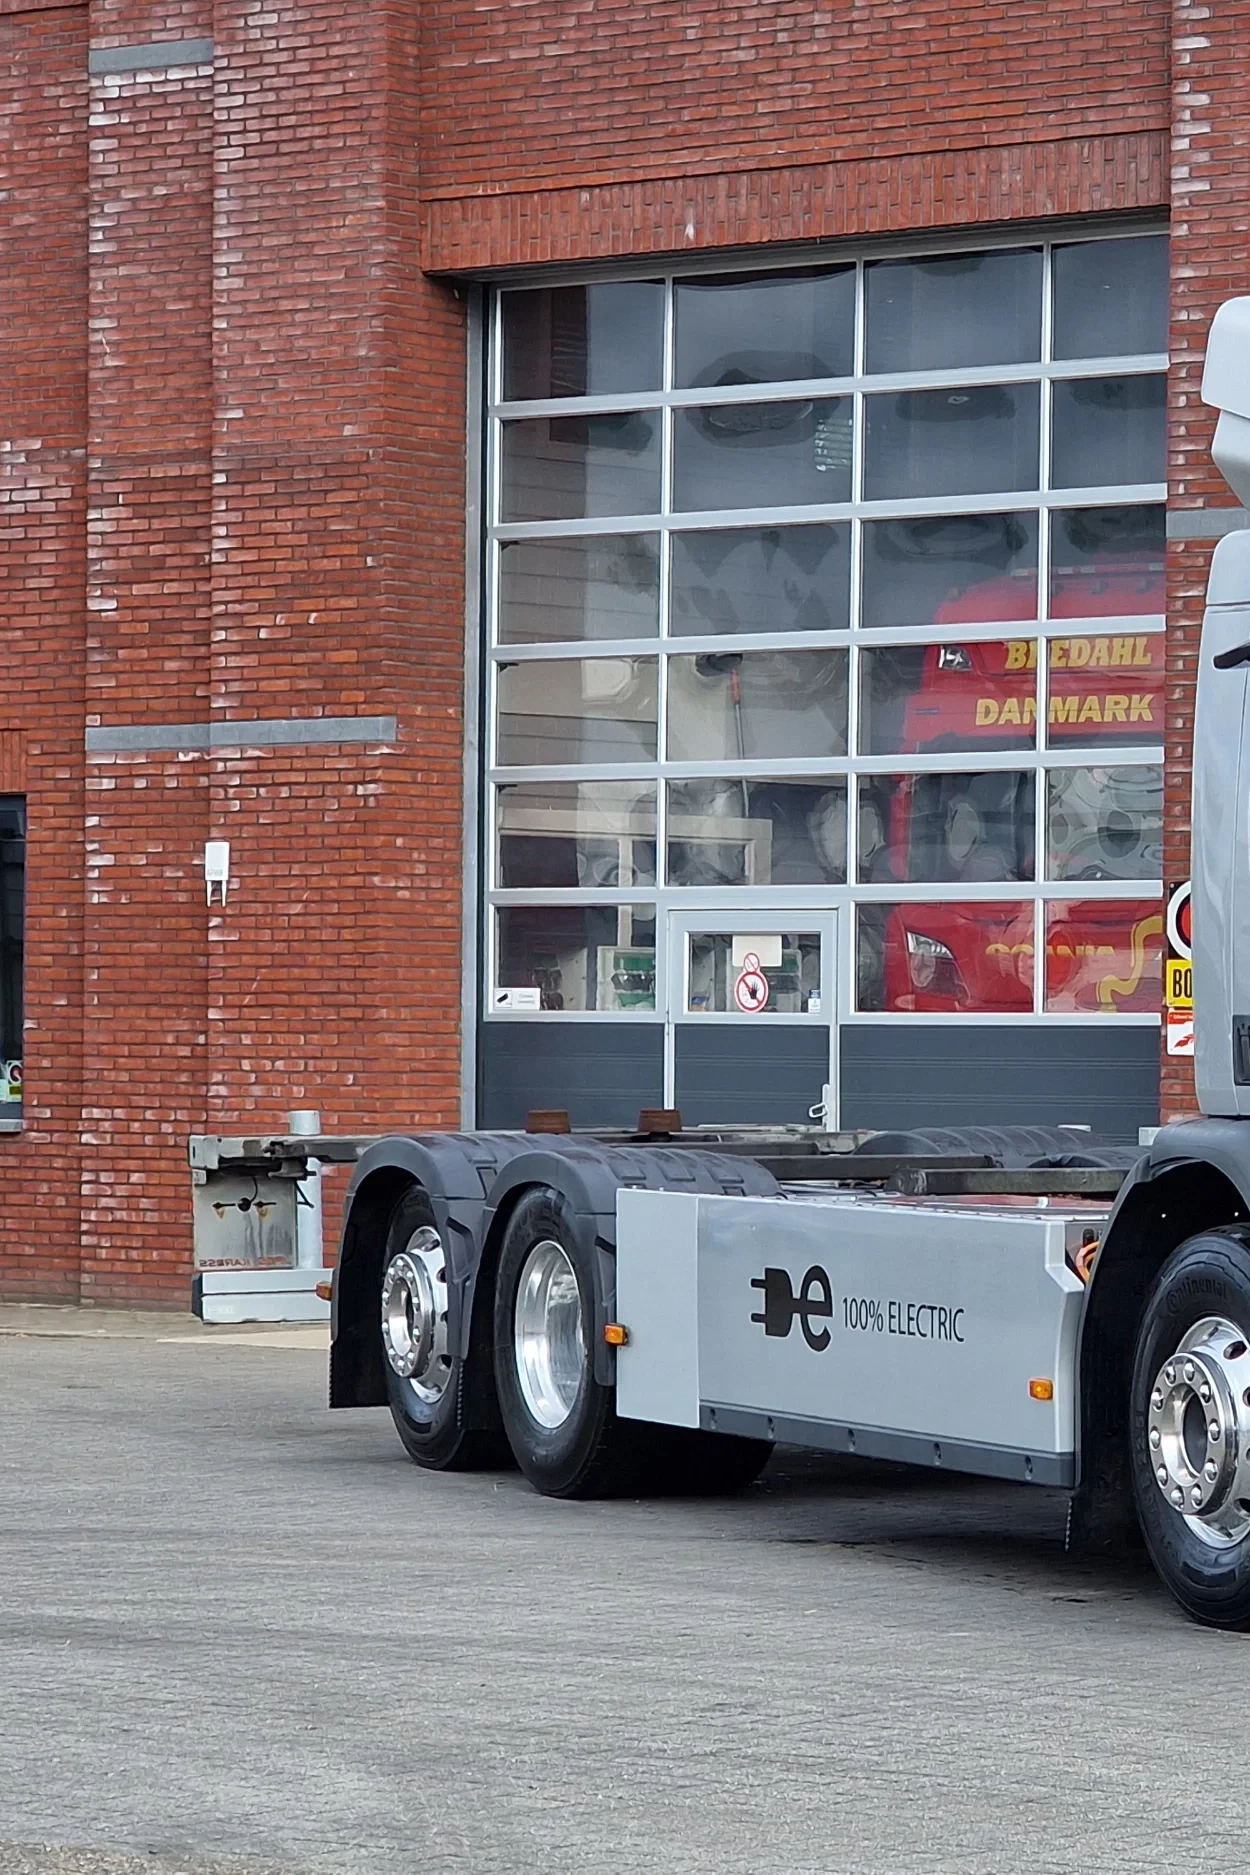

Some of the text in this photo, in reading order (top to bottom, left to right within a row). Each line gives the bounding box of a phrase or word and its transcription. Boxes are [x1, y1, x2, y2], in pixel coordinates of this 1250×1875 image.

[975, 694, 1154, 726] DANMARK
[842, 1297, 965, 1343] 100% ELECTRIC
